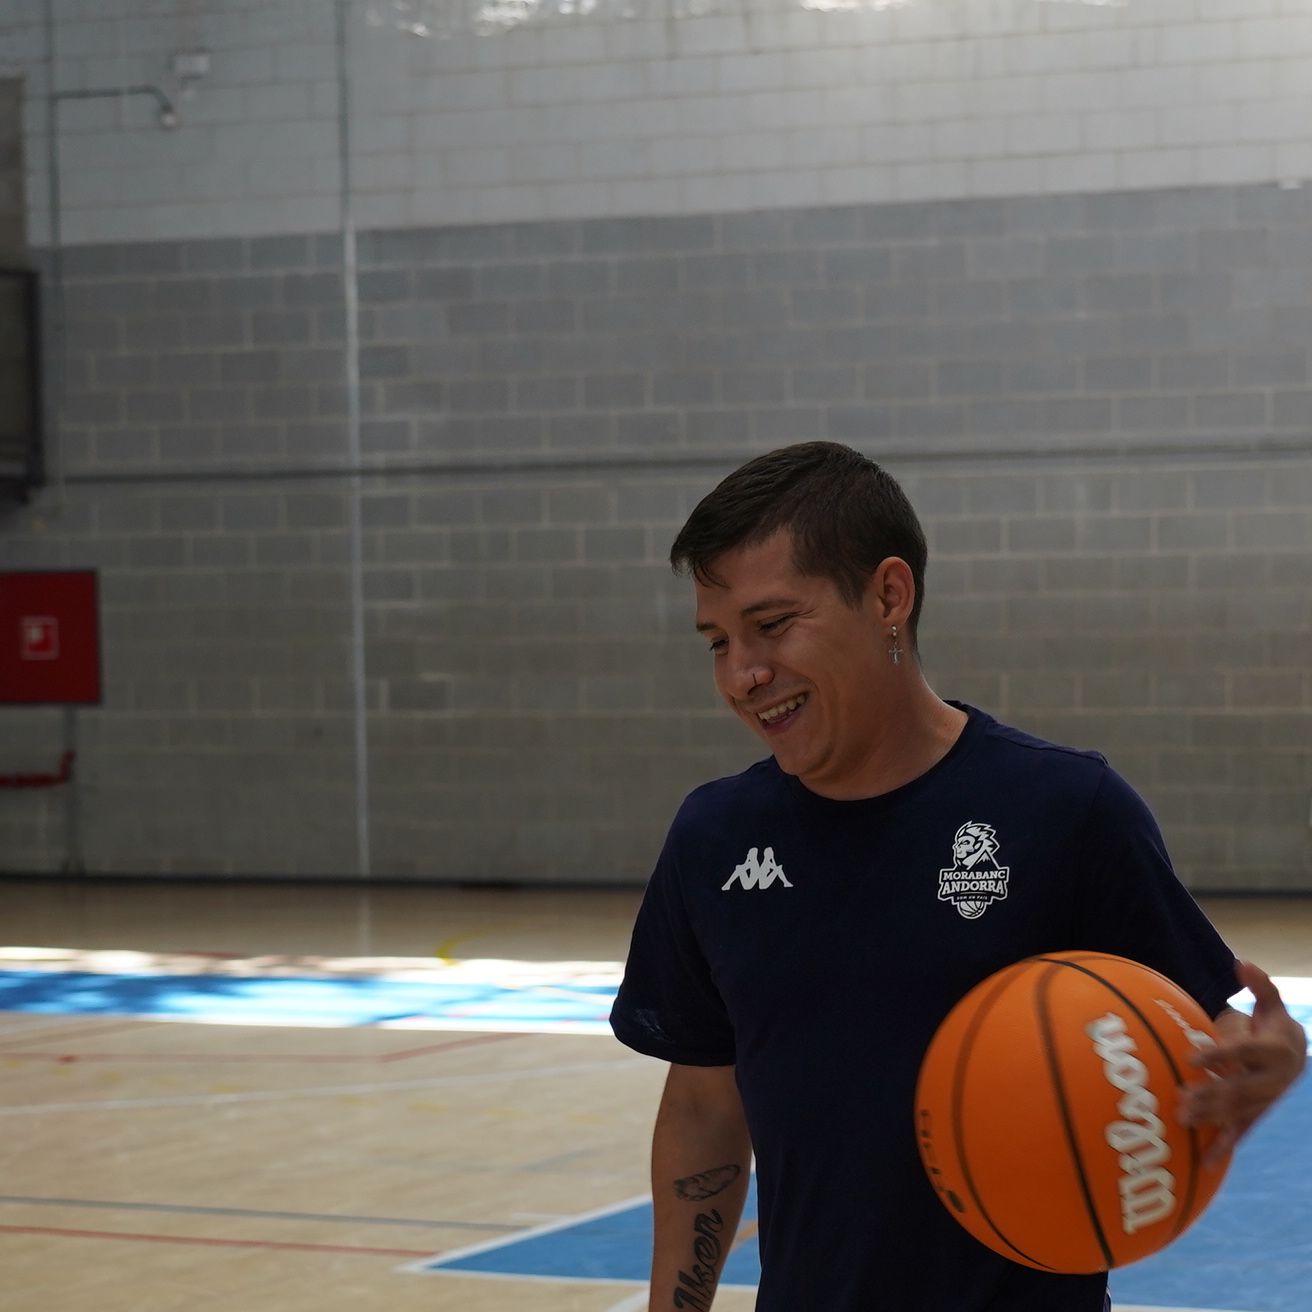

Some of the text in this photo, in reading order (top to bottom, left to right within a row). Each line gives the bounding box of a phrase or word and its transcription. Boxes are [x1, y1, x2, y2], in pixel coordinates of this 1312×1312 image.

[943, 870, 1006, 880] MORABANC
[941, 880, 1005, 895] ANDORRA
[1085, 1012, 1176, 1235] Wilson
